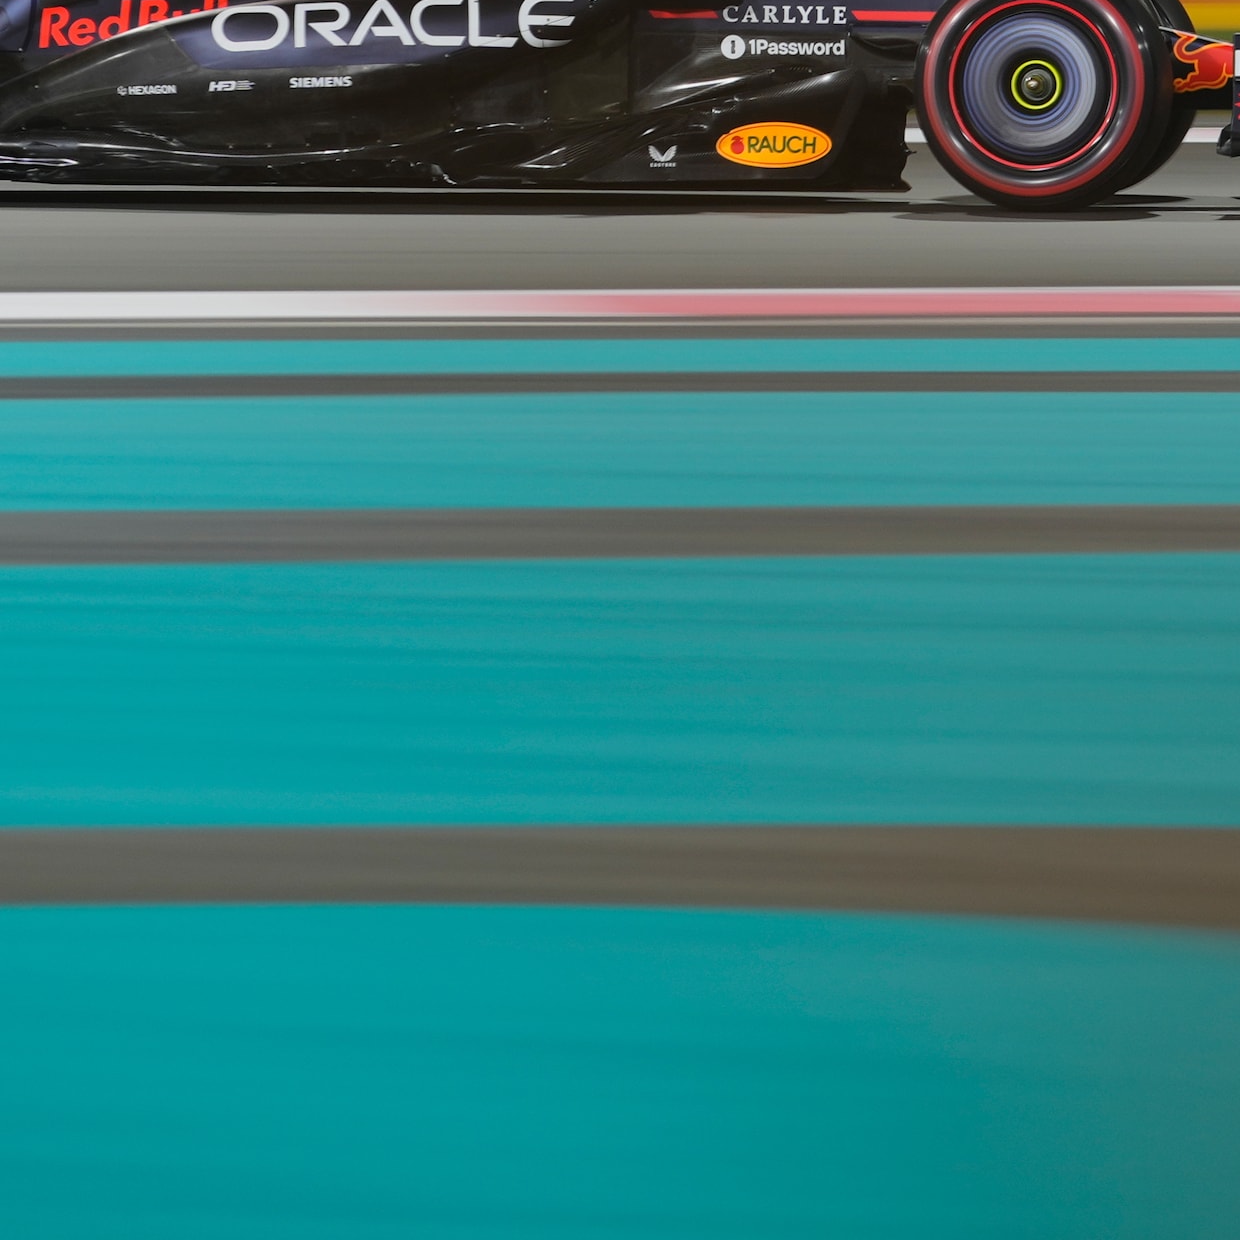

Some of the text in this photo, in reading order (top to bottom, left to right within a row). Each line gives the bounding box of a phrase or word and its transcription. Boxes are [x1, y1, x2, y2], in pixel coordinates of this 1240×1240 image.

[722, 5, 848, 25] CARLYLE
[748, 38, 846, 56] 1Password
[128, 84, 178, 96] HEXAGON
[289, 75, 353, 89] SIEMENS
[747, 135, 817, 154] RAUCH
